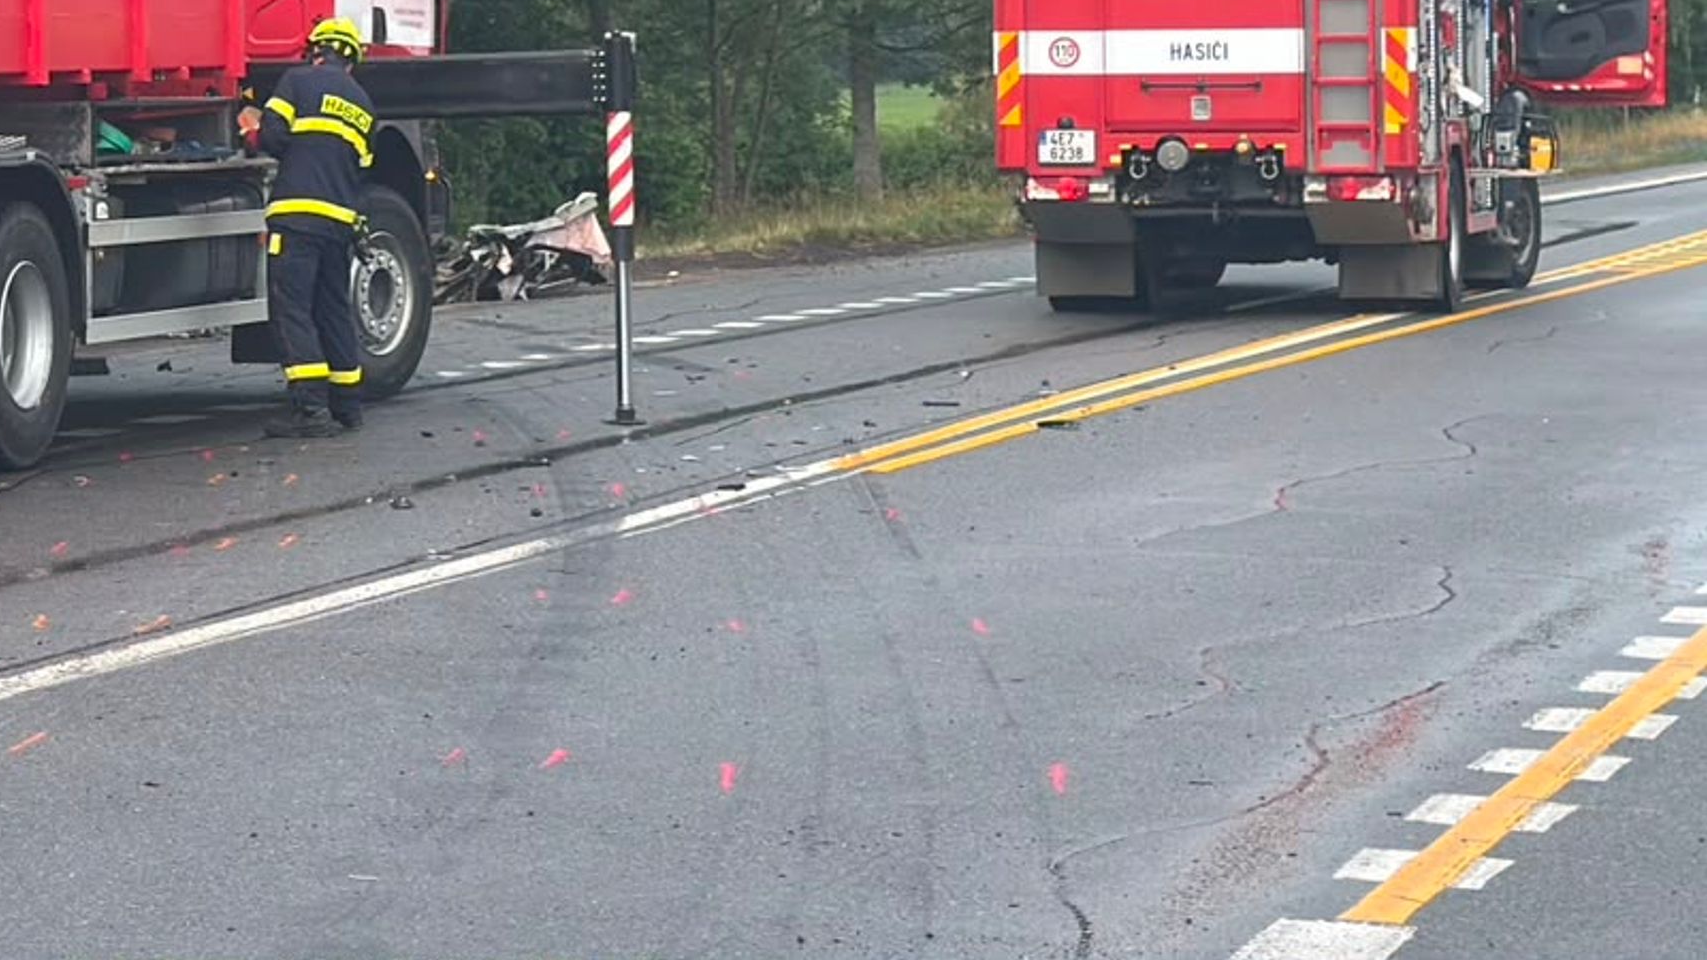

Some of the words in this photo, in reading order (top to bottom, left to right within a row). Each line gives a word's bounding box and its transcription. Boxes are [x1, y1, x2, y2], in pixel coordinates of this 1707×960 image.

[1170, 41, 1228, 61] HASIČI
[1050, 132, 1075, 145] 4E7
[1050, 147, 1083, 160] 6238
